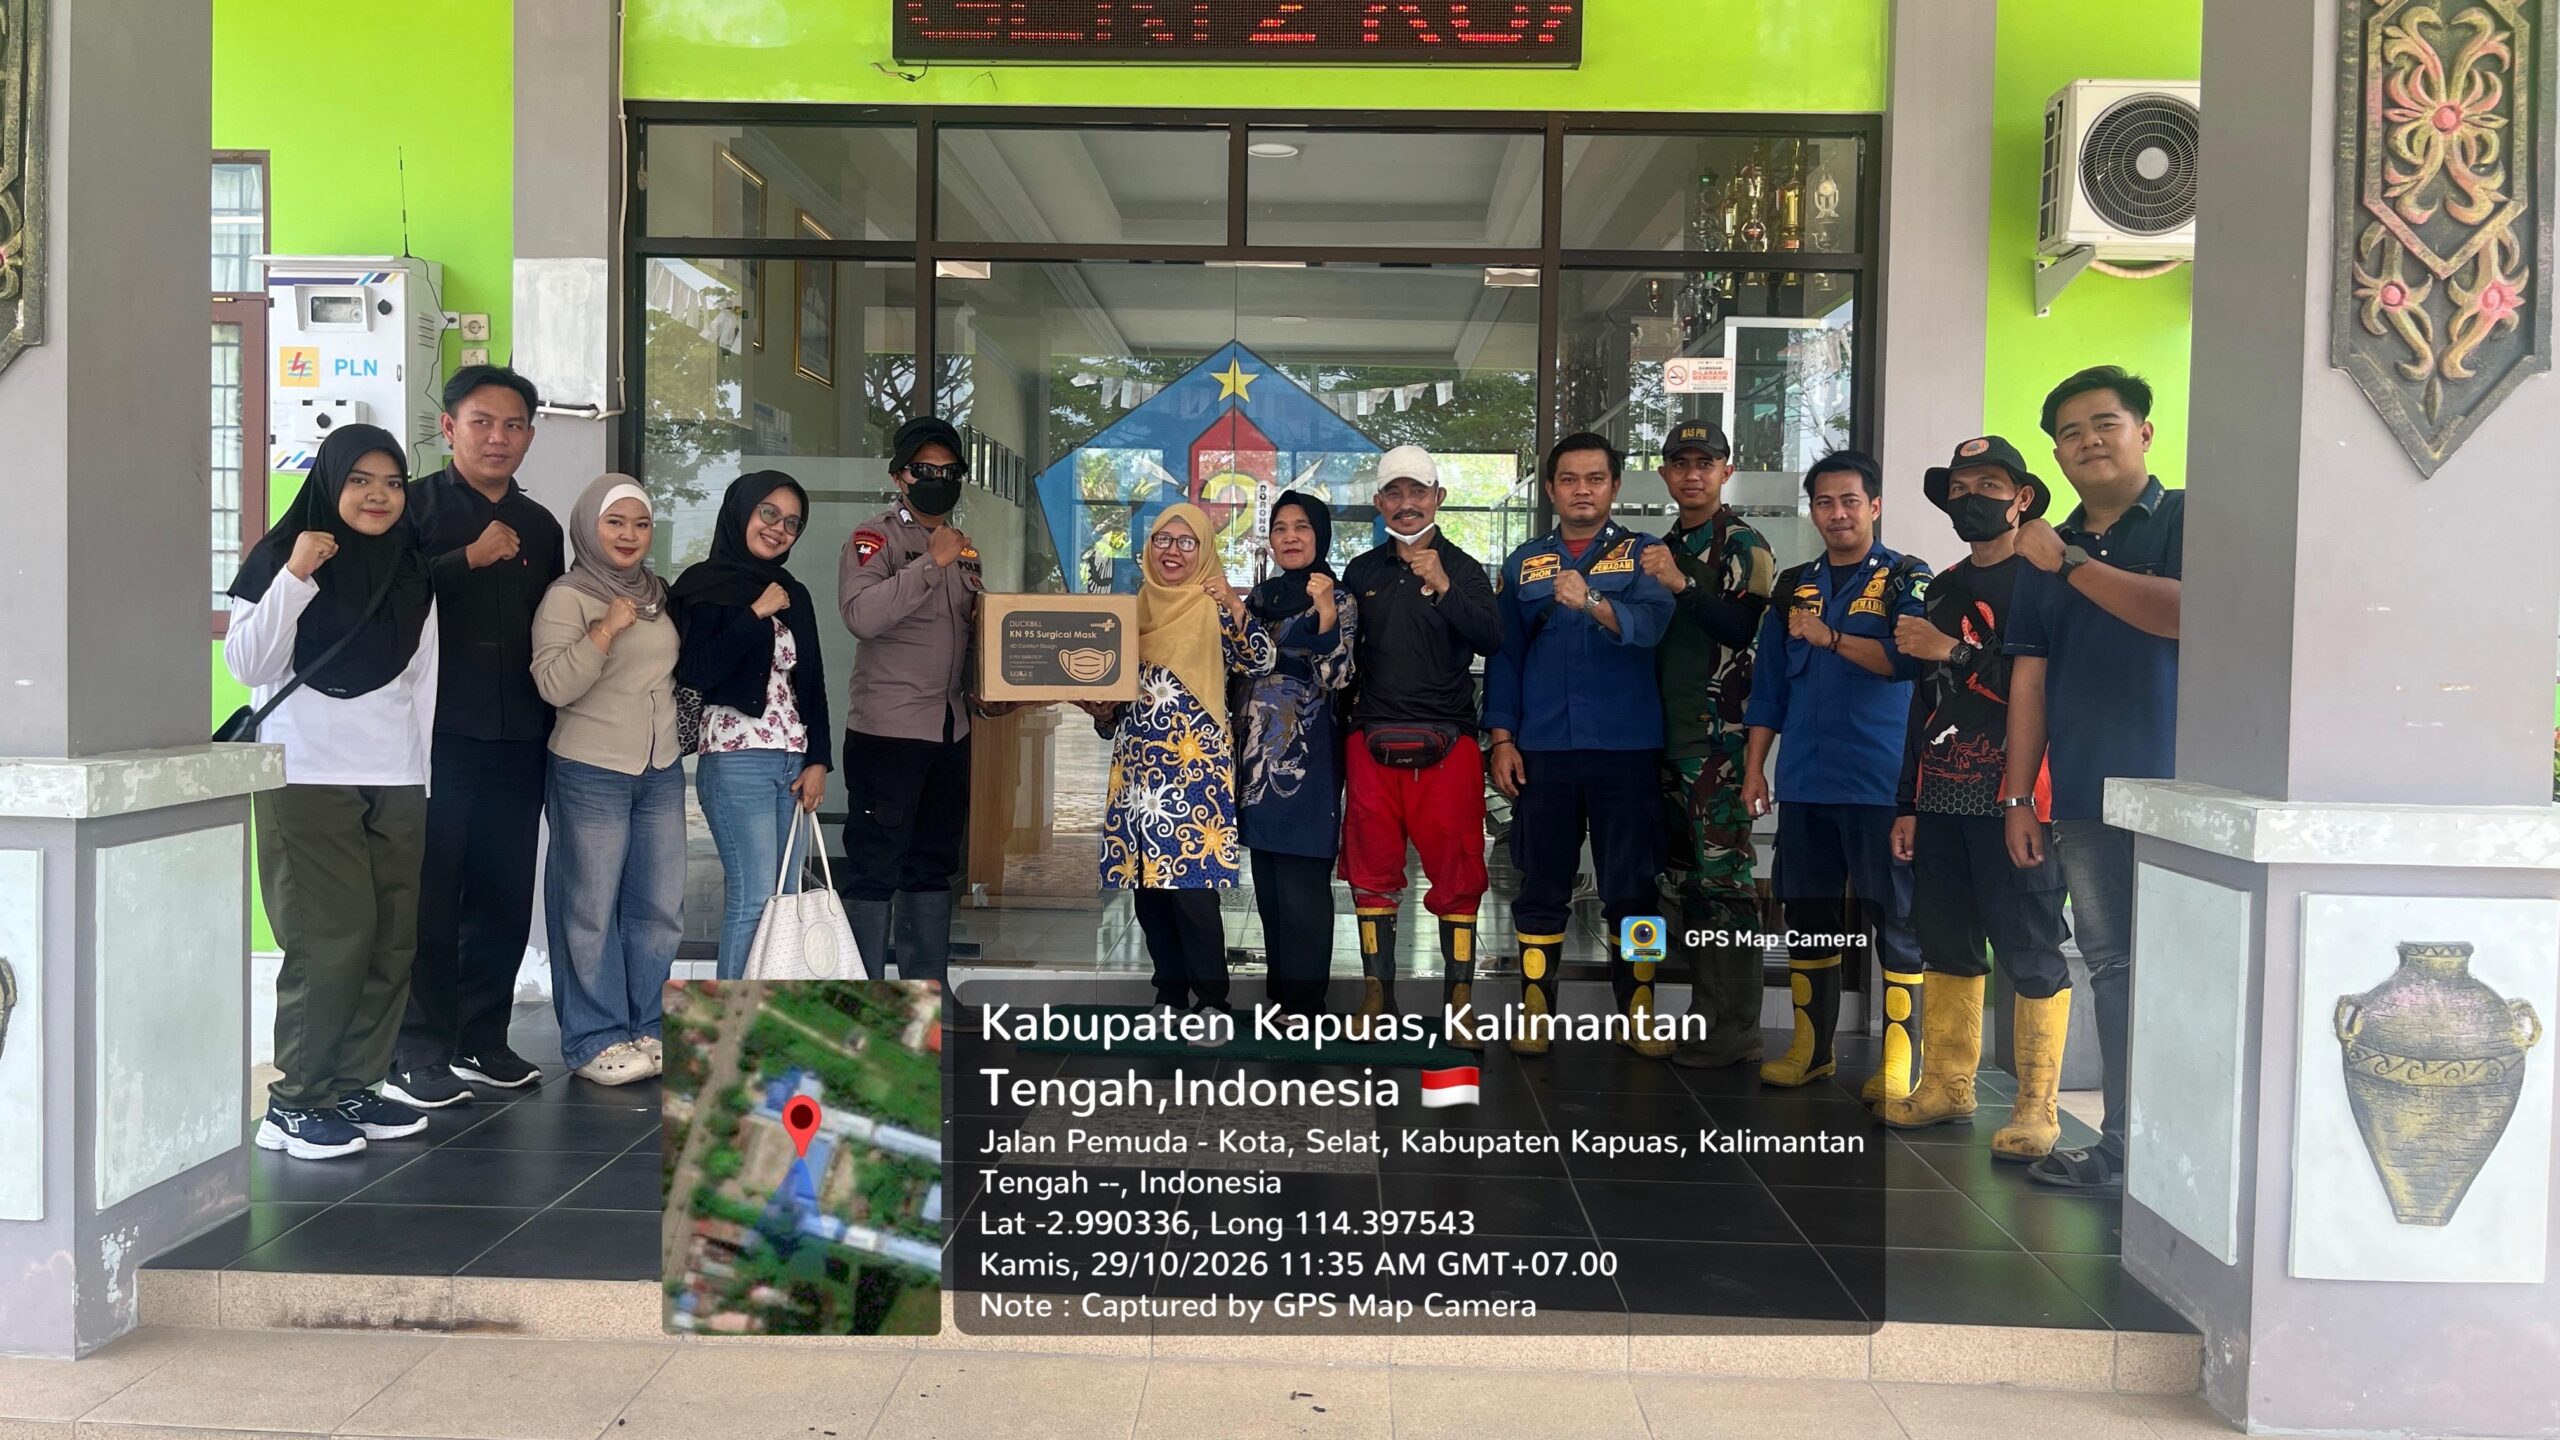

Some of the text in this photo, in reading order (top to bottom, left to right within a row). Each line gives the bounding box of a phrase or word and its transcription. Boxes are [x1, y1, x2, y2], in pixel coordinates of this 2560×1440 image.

[334, 358, 378, 377] PLN
[1259, 485, 1267, 533] DORONG
[1593, 561, 1632, 573] PEMADAM
[1527, 568, 1552, 581] JHON
[1037, 631, 1072, 640] Surgical
[1074, 631, 1097, 639] Mask
